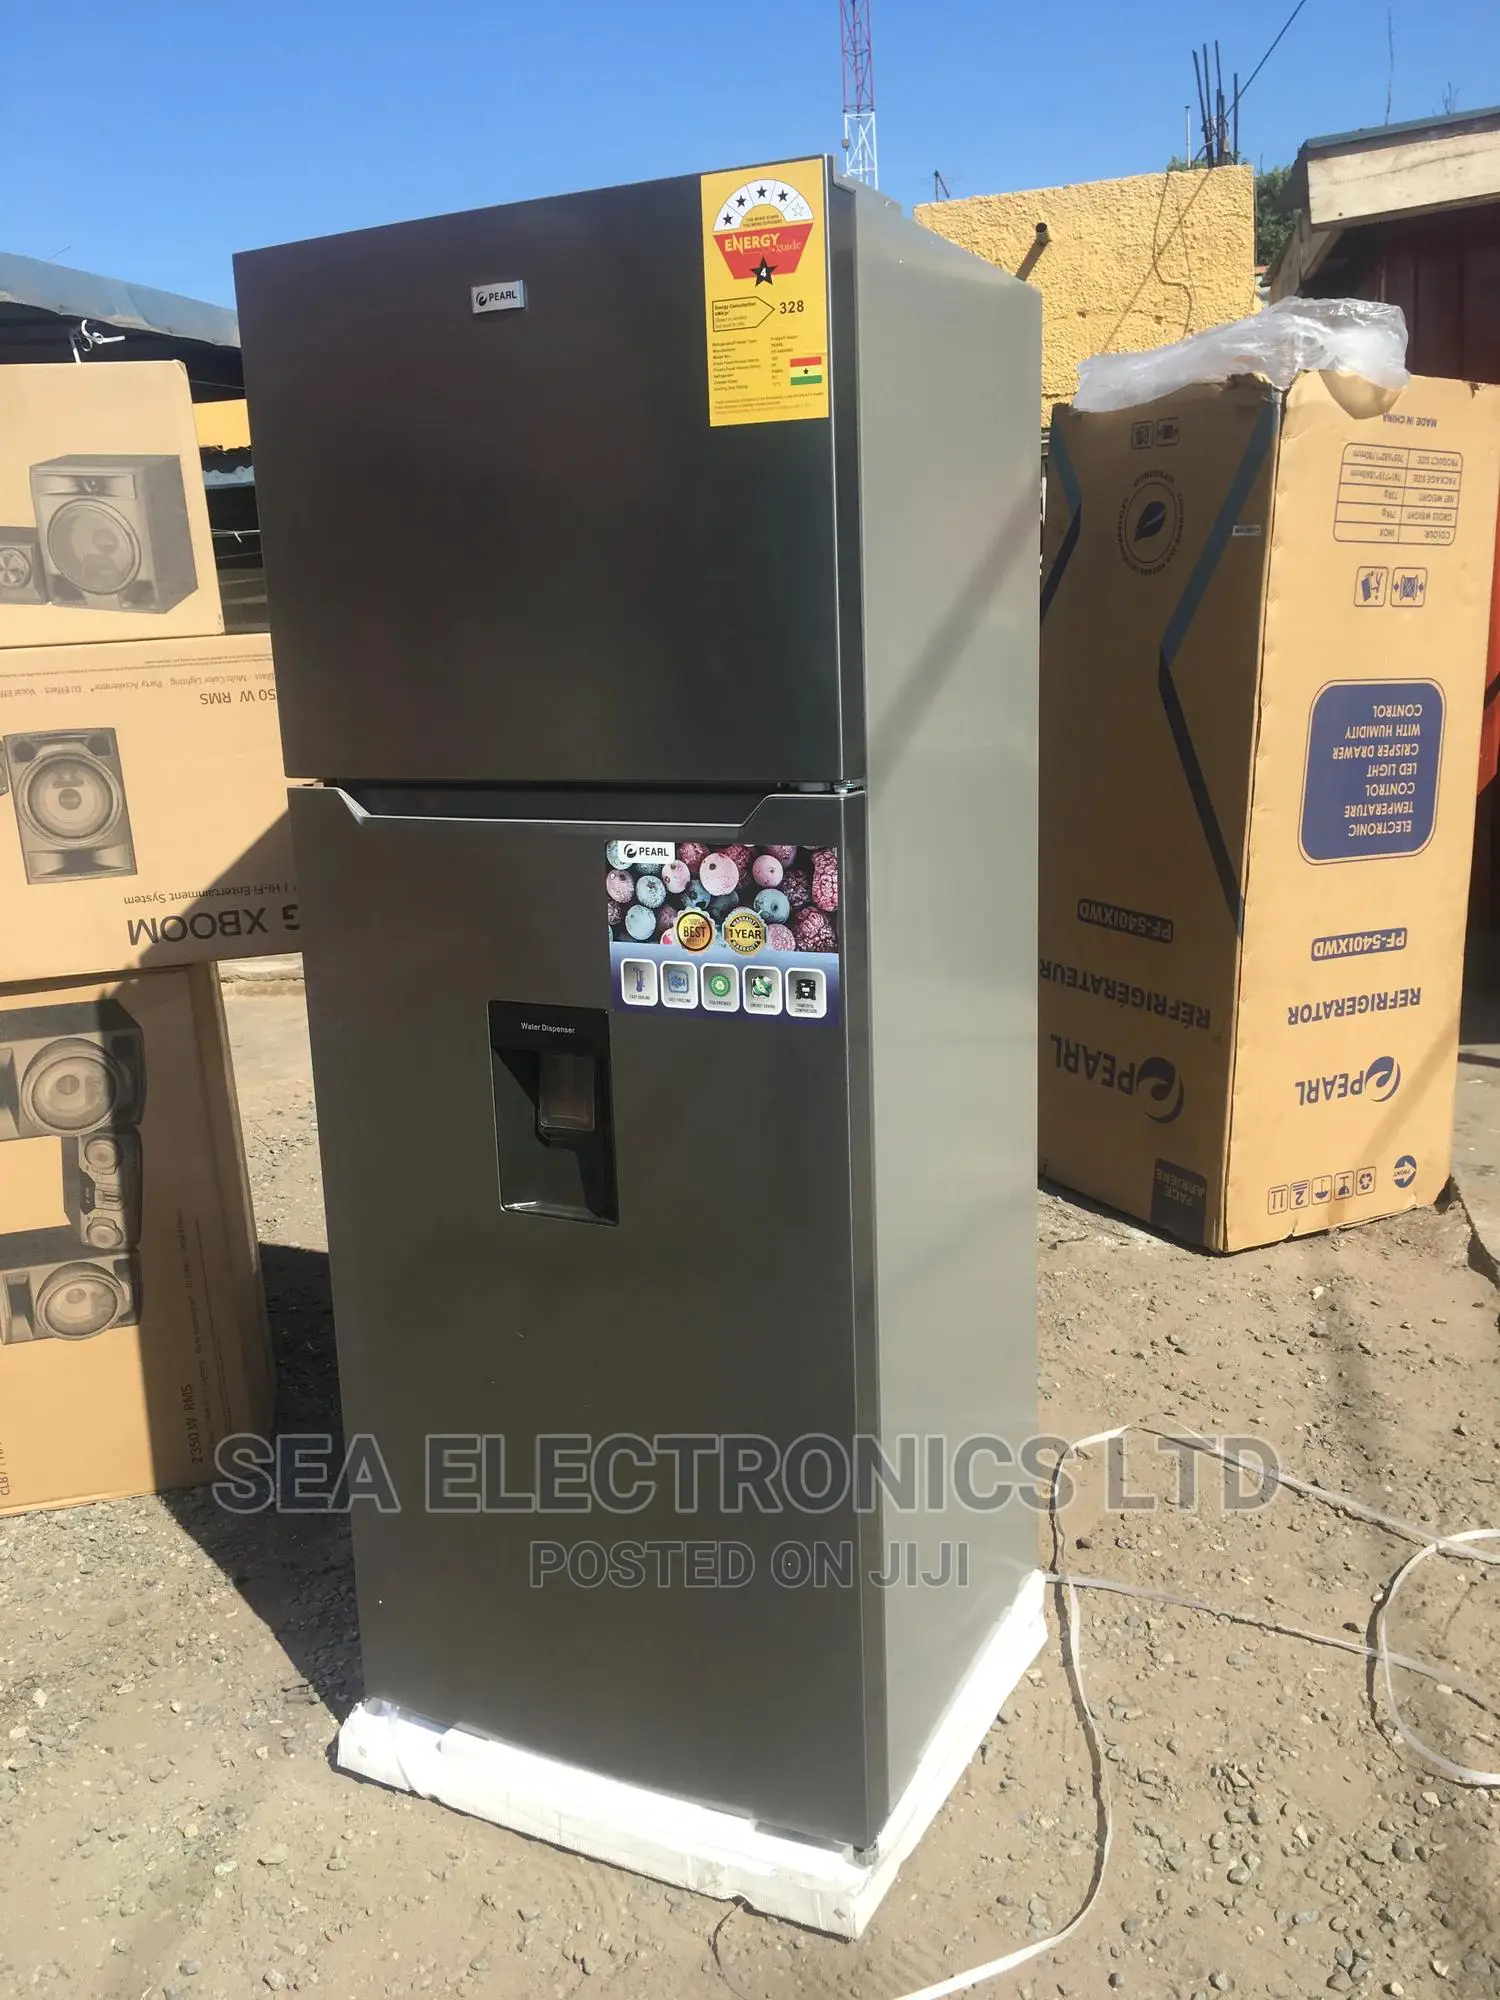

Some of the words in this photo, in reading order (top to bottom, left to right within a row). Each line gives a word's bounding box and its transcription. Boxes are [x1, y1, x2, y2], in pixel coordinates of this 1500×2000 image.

[724, 232, 780, 255] ENERGY
[776, 239, 801, 254] guide
[760, 267, 767, 278] 4
[488, 290, 518, 302] PEARL
[779, 300, 805, 315] 328
[1382, 412, 1406, 424] CHINA
[1406, 415, 1414, 425] IN
[1416, 417, 1438, 428] MADE
[1430, 456, 1459, 467] PRODUCT
[1427, 474, 1457, 485] PACKAGE
[1431, 512, 1452, 522] GROSS
[1379, 528, 1395, 537] INOX
[1423, 530, 1451, 540] COLOUR:
[142, 679, 163, 689] Party
[170, 676, 203, 689] Lighting
[16, 687, 37, 697] Vocal
[44, 686, 70, 696] Effect
[239, 689, 256, 702] W
[200, 691, 232, 705] RMS
[1372, 704, 1423, 718] CONTROL
[1344, 725, 1393, 739] HUMIDITY
[1396, 723, 1421, 737] WITH
[1332, 746, 1374, 760] DRAWER
[1377, 743, 1420, 758] CRISPER
[1366, 764, 1396, 777] LIGHT
[1399, 762, 1417, 775] LED
[1365, 782, 1416, 796] CONTROL
[1343, 801, 1414, 818] TEMPERATURE
[1347, 820, 1412, 837] ELECTRONIC
[638, 847, 669, 857] PEARL
[170, 884, 251, 901] Entertainment
[254, 882, 280, 895] Hi-Fi
[123, 891, 167, 905] System
[127, 906, 269, 946] XBOOM
[1078, 900, 1172, 941] PF-540IXWD
[683, 926, 706, 938] BEST
[728, 929, 734, 938] 1
[735, 929, 762, 939] YEAR
[1312, 929, 1406, 959] PF-540IXWD
[1039, 957, 1211, 1030] RÉFRIGÉRATEUR
[1287, 986, 1422, 1026] REFRIGERATOR
[520, 1022, 541, 1031] Water
[541, 1023, 575, 1034] Dispenser
[1050, 1033, 1137, 1096] PEARL
[1295, 1069, 1365, 1106] PEARL
[1393, 1167, 1411, 1178] FRONT
[1295, 1190, 1304, 1205] 2
[181, 1384, 196, 1411] RMS
[186, 1416, 198, 1432] W
